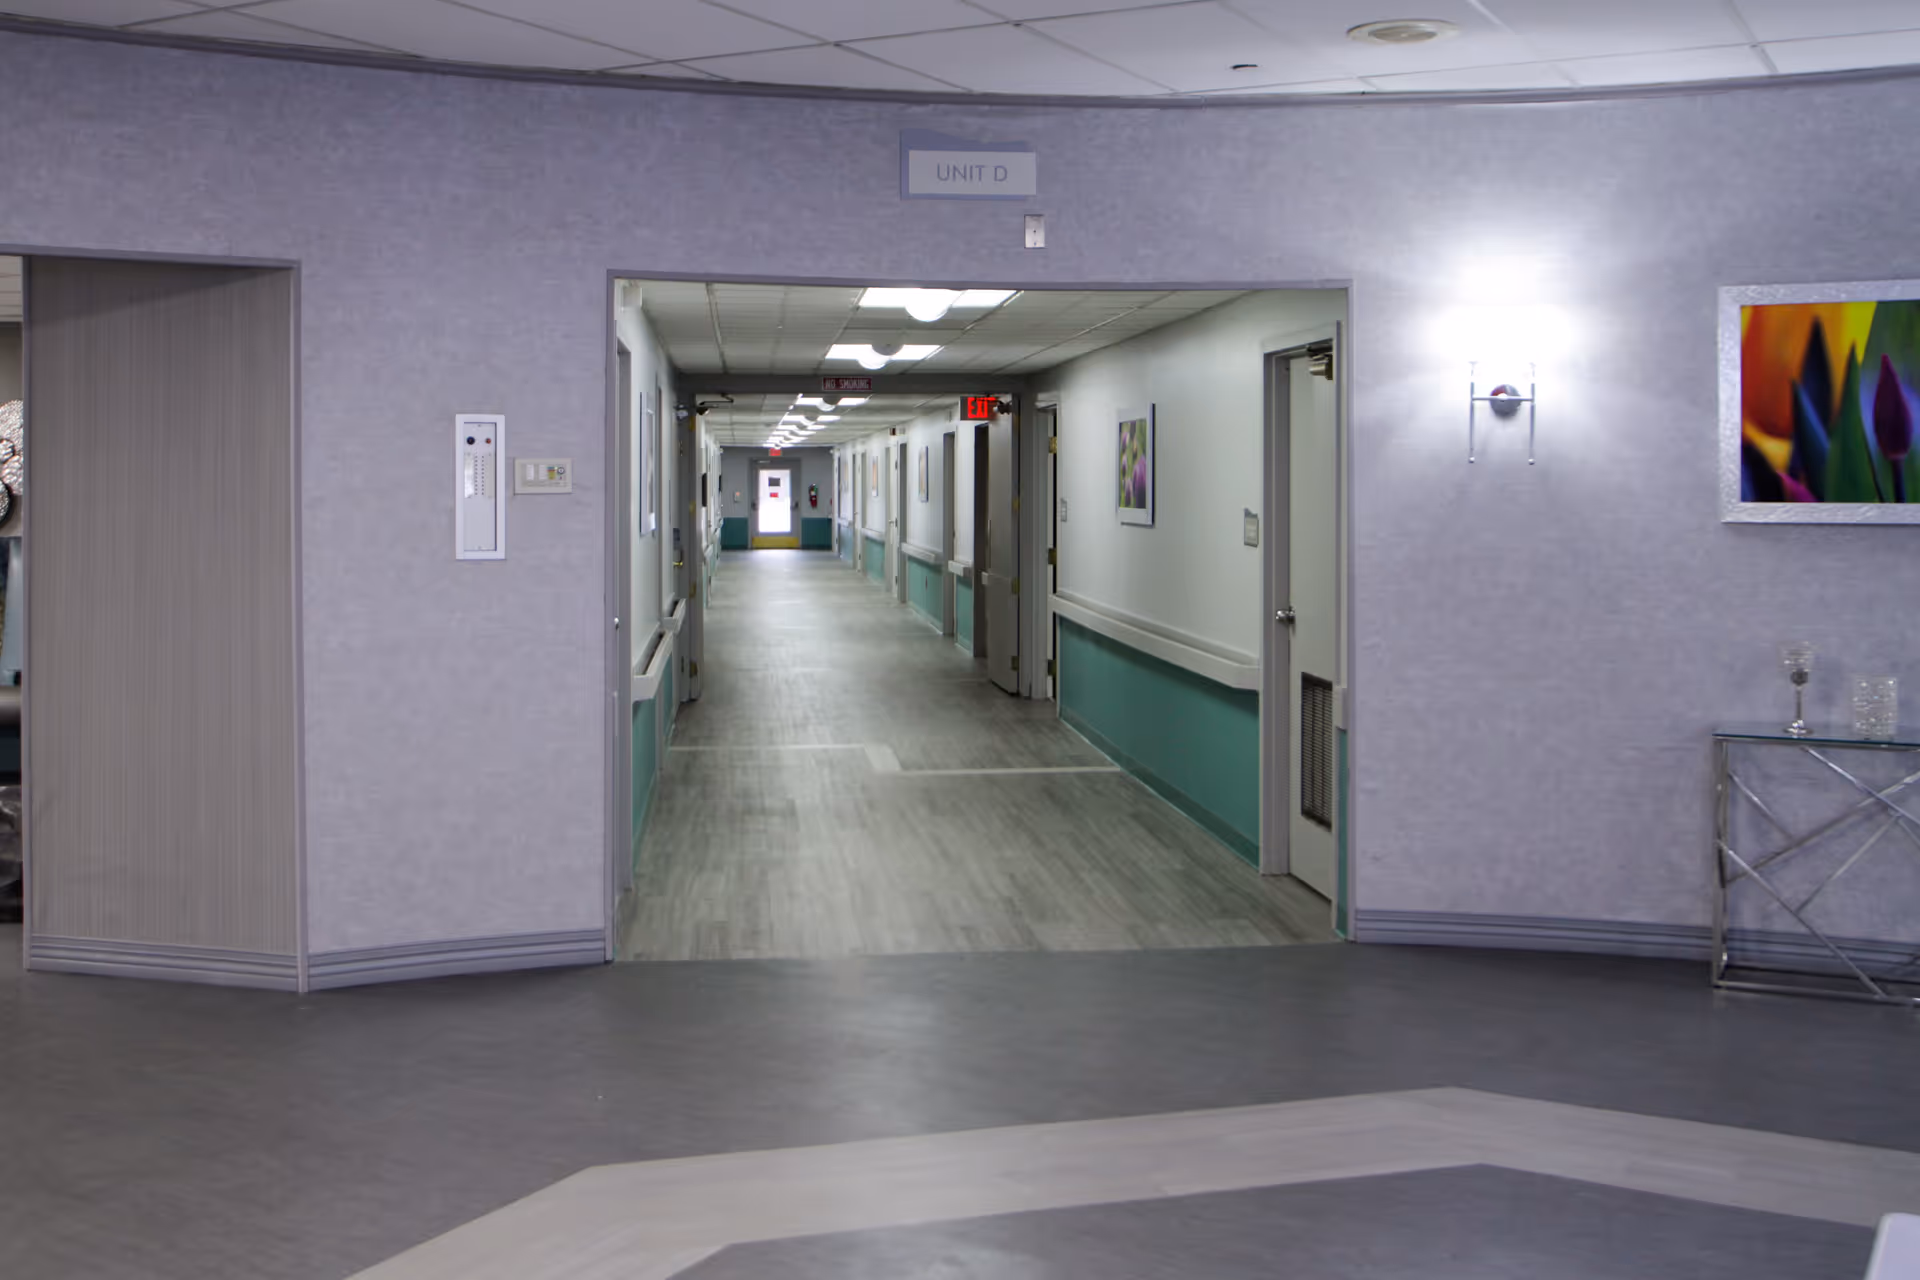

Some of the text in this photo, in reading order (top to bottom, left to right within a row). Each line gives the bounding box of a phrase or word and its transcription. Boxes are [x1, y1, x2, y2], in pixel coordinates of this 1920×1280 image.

[936, 163, 1008, 182] UNIT D
[824, 378, 869, 390] NO SMOKING
